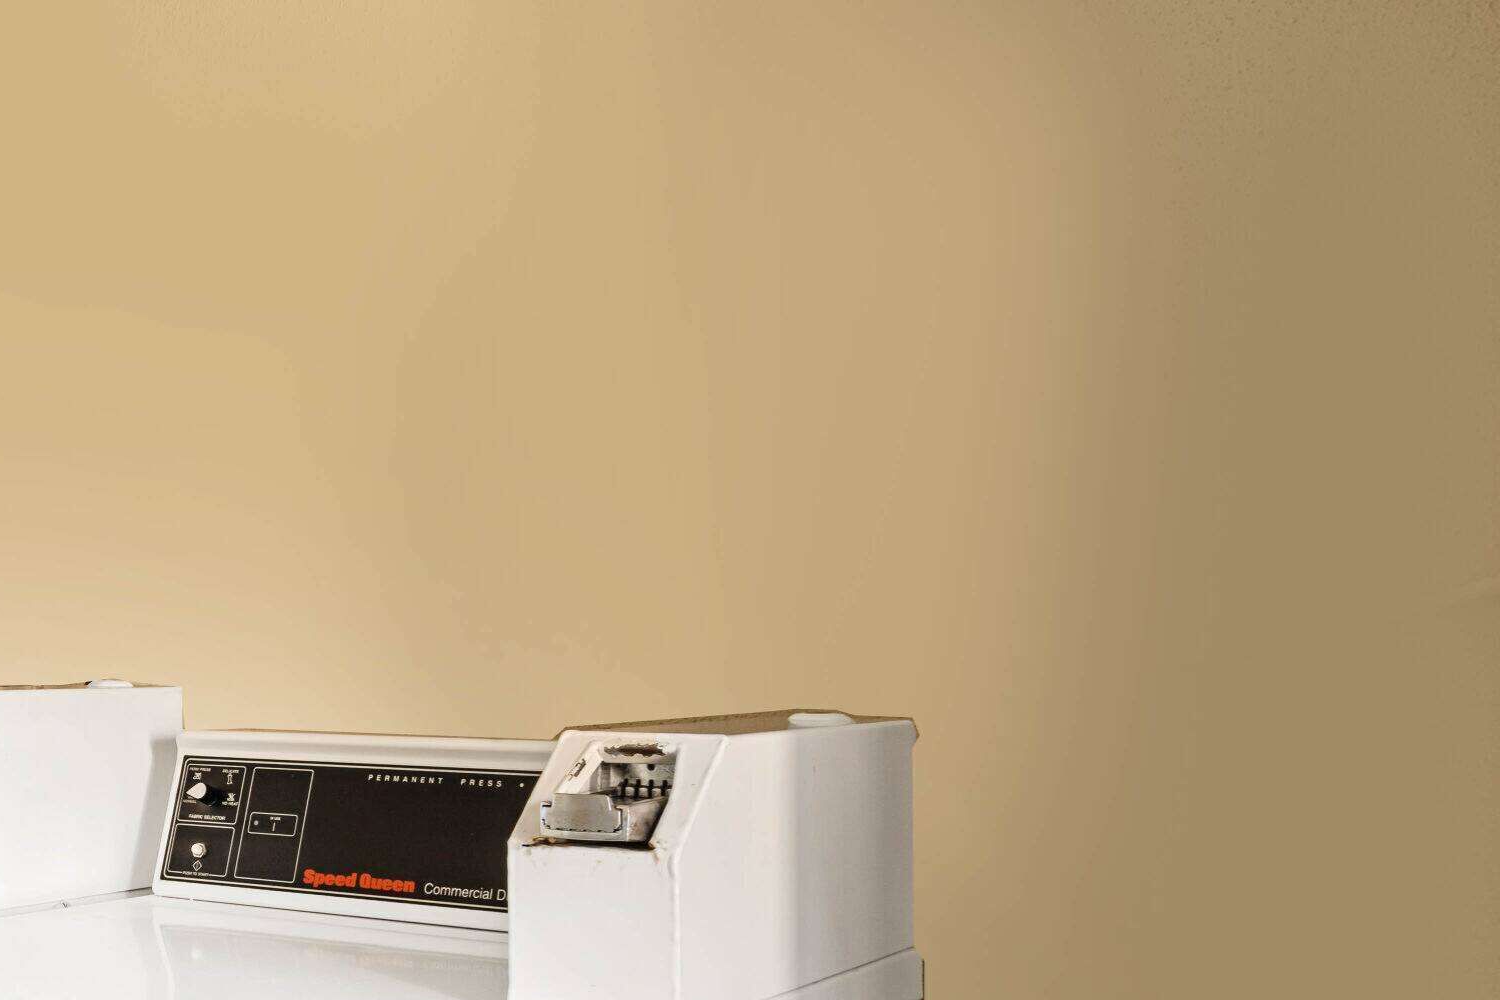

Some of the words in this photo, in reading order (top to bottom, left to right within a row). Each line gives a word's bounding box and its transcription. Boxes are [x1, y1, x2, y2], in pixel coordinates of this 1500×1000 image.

[367, 774, 445, 784] PERMANENT
[460, 778, 502, 788] PRESS
[303, 868, 358, 888] Speed
[359, 873, 416, 893] Queen
[423, 882, 493, 900] Commercial
